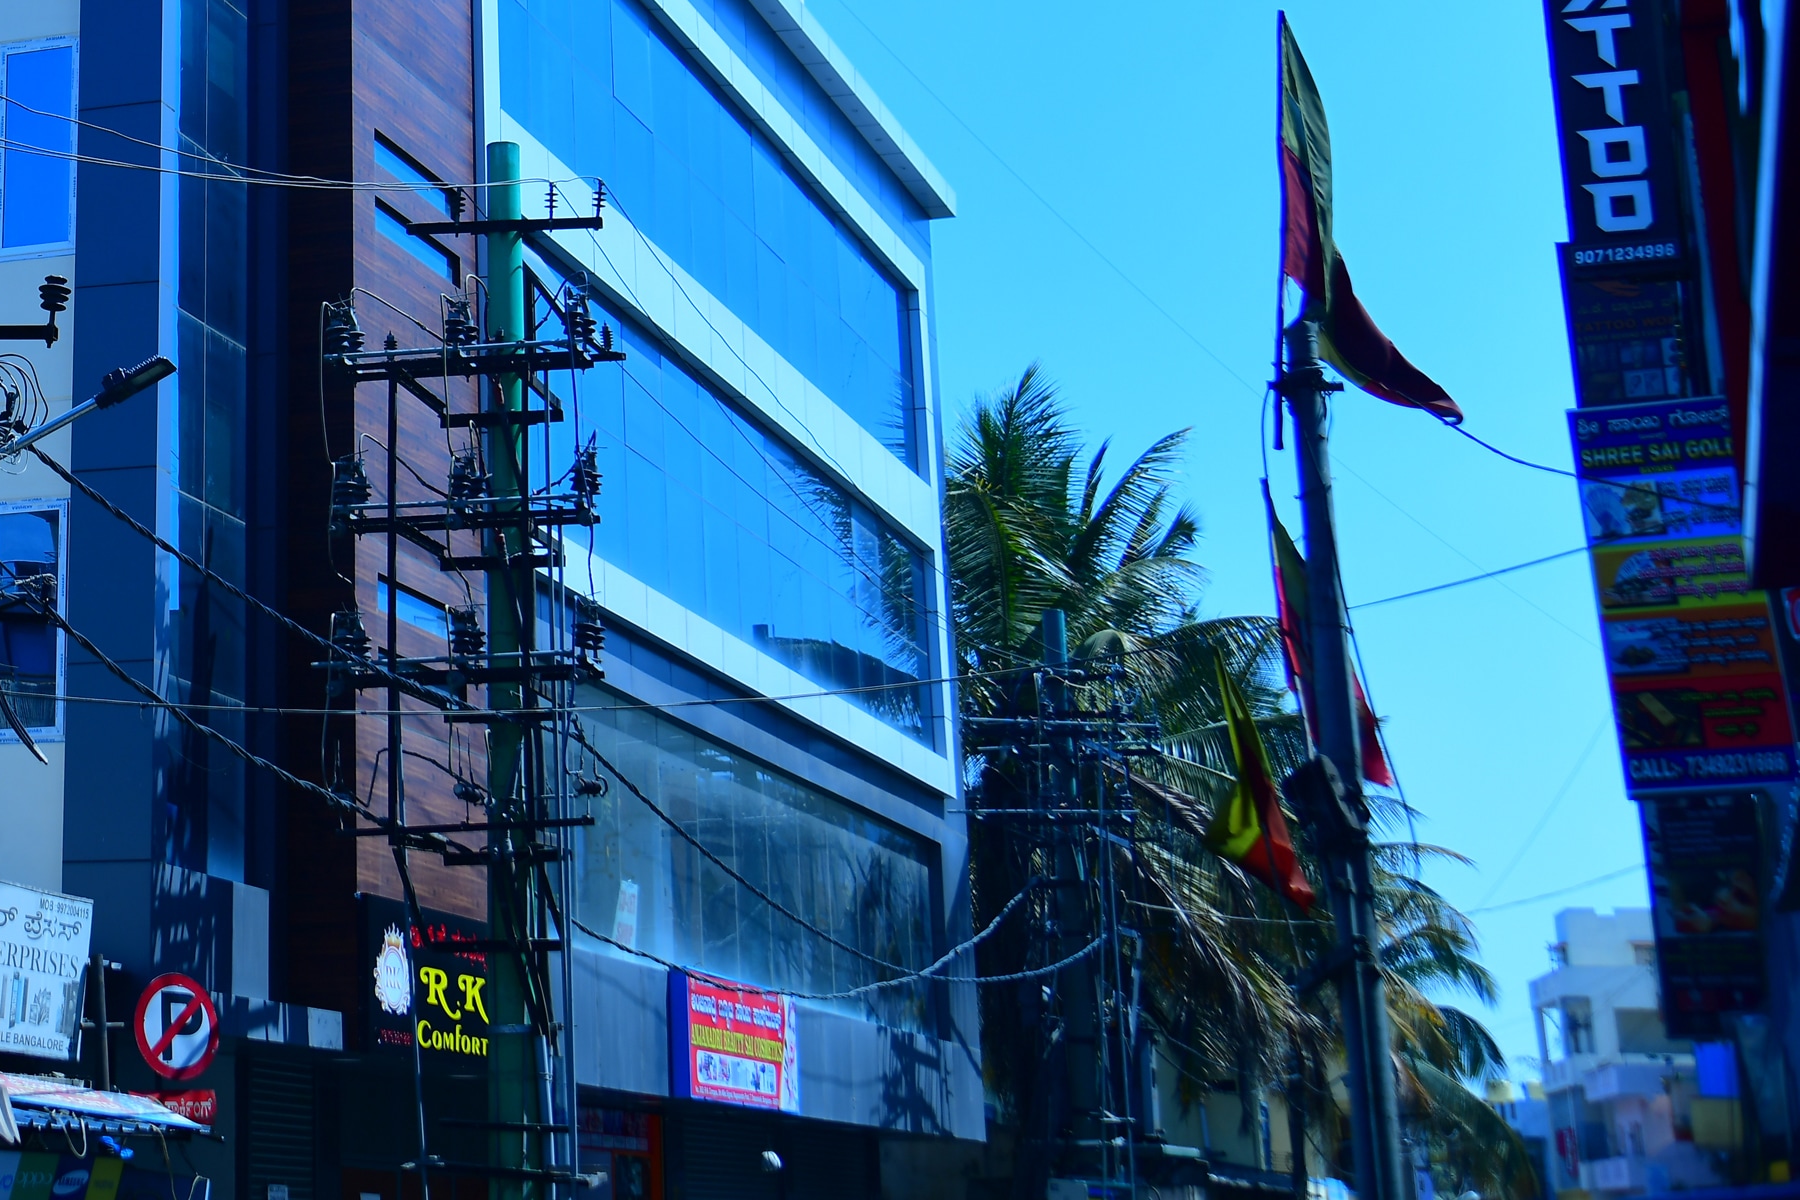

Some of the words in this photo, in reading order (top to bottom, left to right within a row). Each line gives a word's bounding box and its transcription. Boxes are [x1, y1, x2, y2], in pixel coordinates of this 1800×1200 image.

[1574, 242, 1676, 265] 9071234996
[1581, 444, 1645, 468] SHREE
[1648, 440, 1681, 463] SAI
[13, 1033, 64, 1052] BANGALORE
